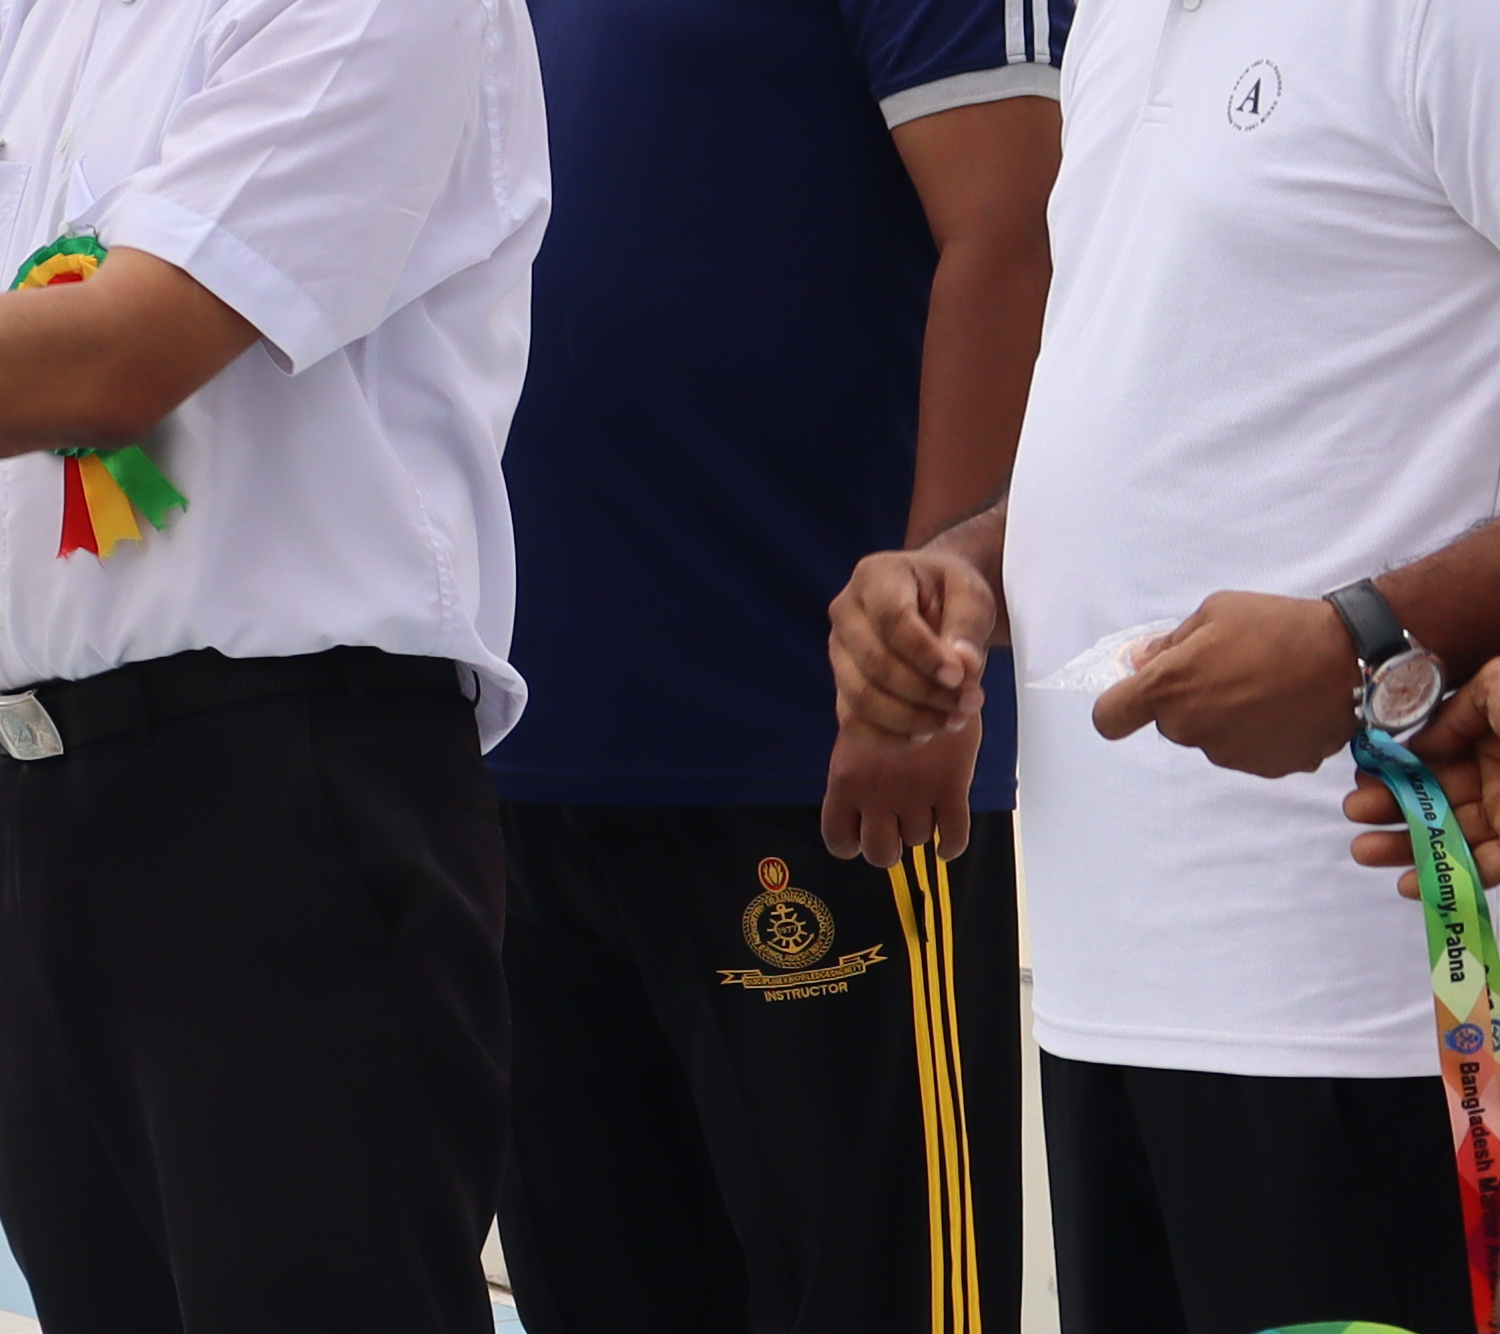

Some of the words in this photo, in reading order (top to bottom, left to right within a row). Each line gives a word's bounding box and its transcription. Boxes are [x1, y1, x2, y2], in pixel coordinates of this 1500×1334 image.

[1236, 77, 1261, 115] A
[1406, 771, 1438, 822] Marine
[1445, 921, 1468, 984] Pabna
[763, 981, 848, 1002] INSTRUCTOR
[1460, 1061, 1495, 1172] Bangladesh
